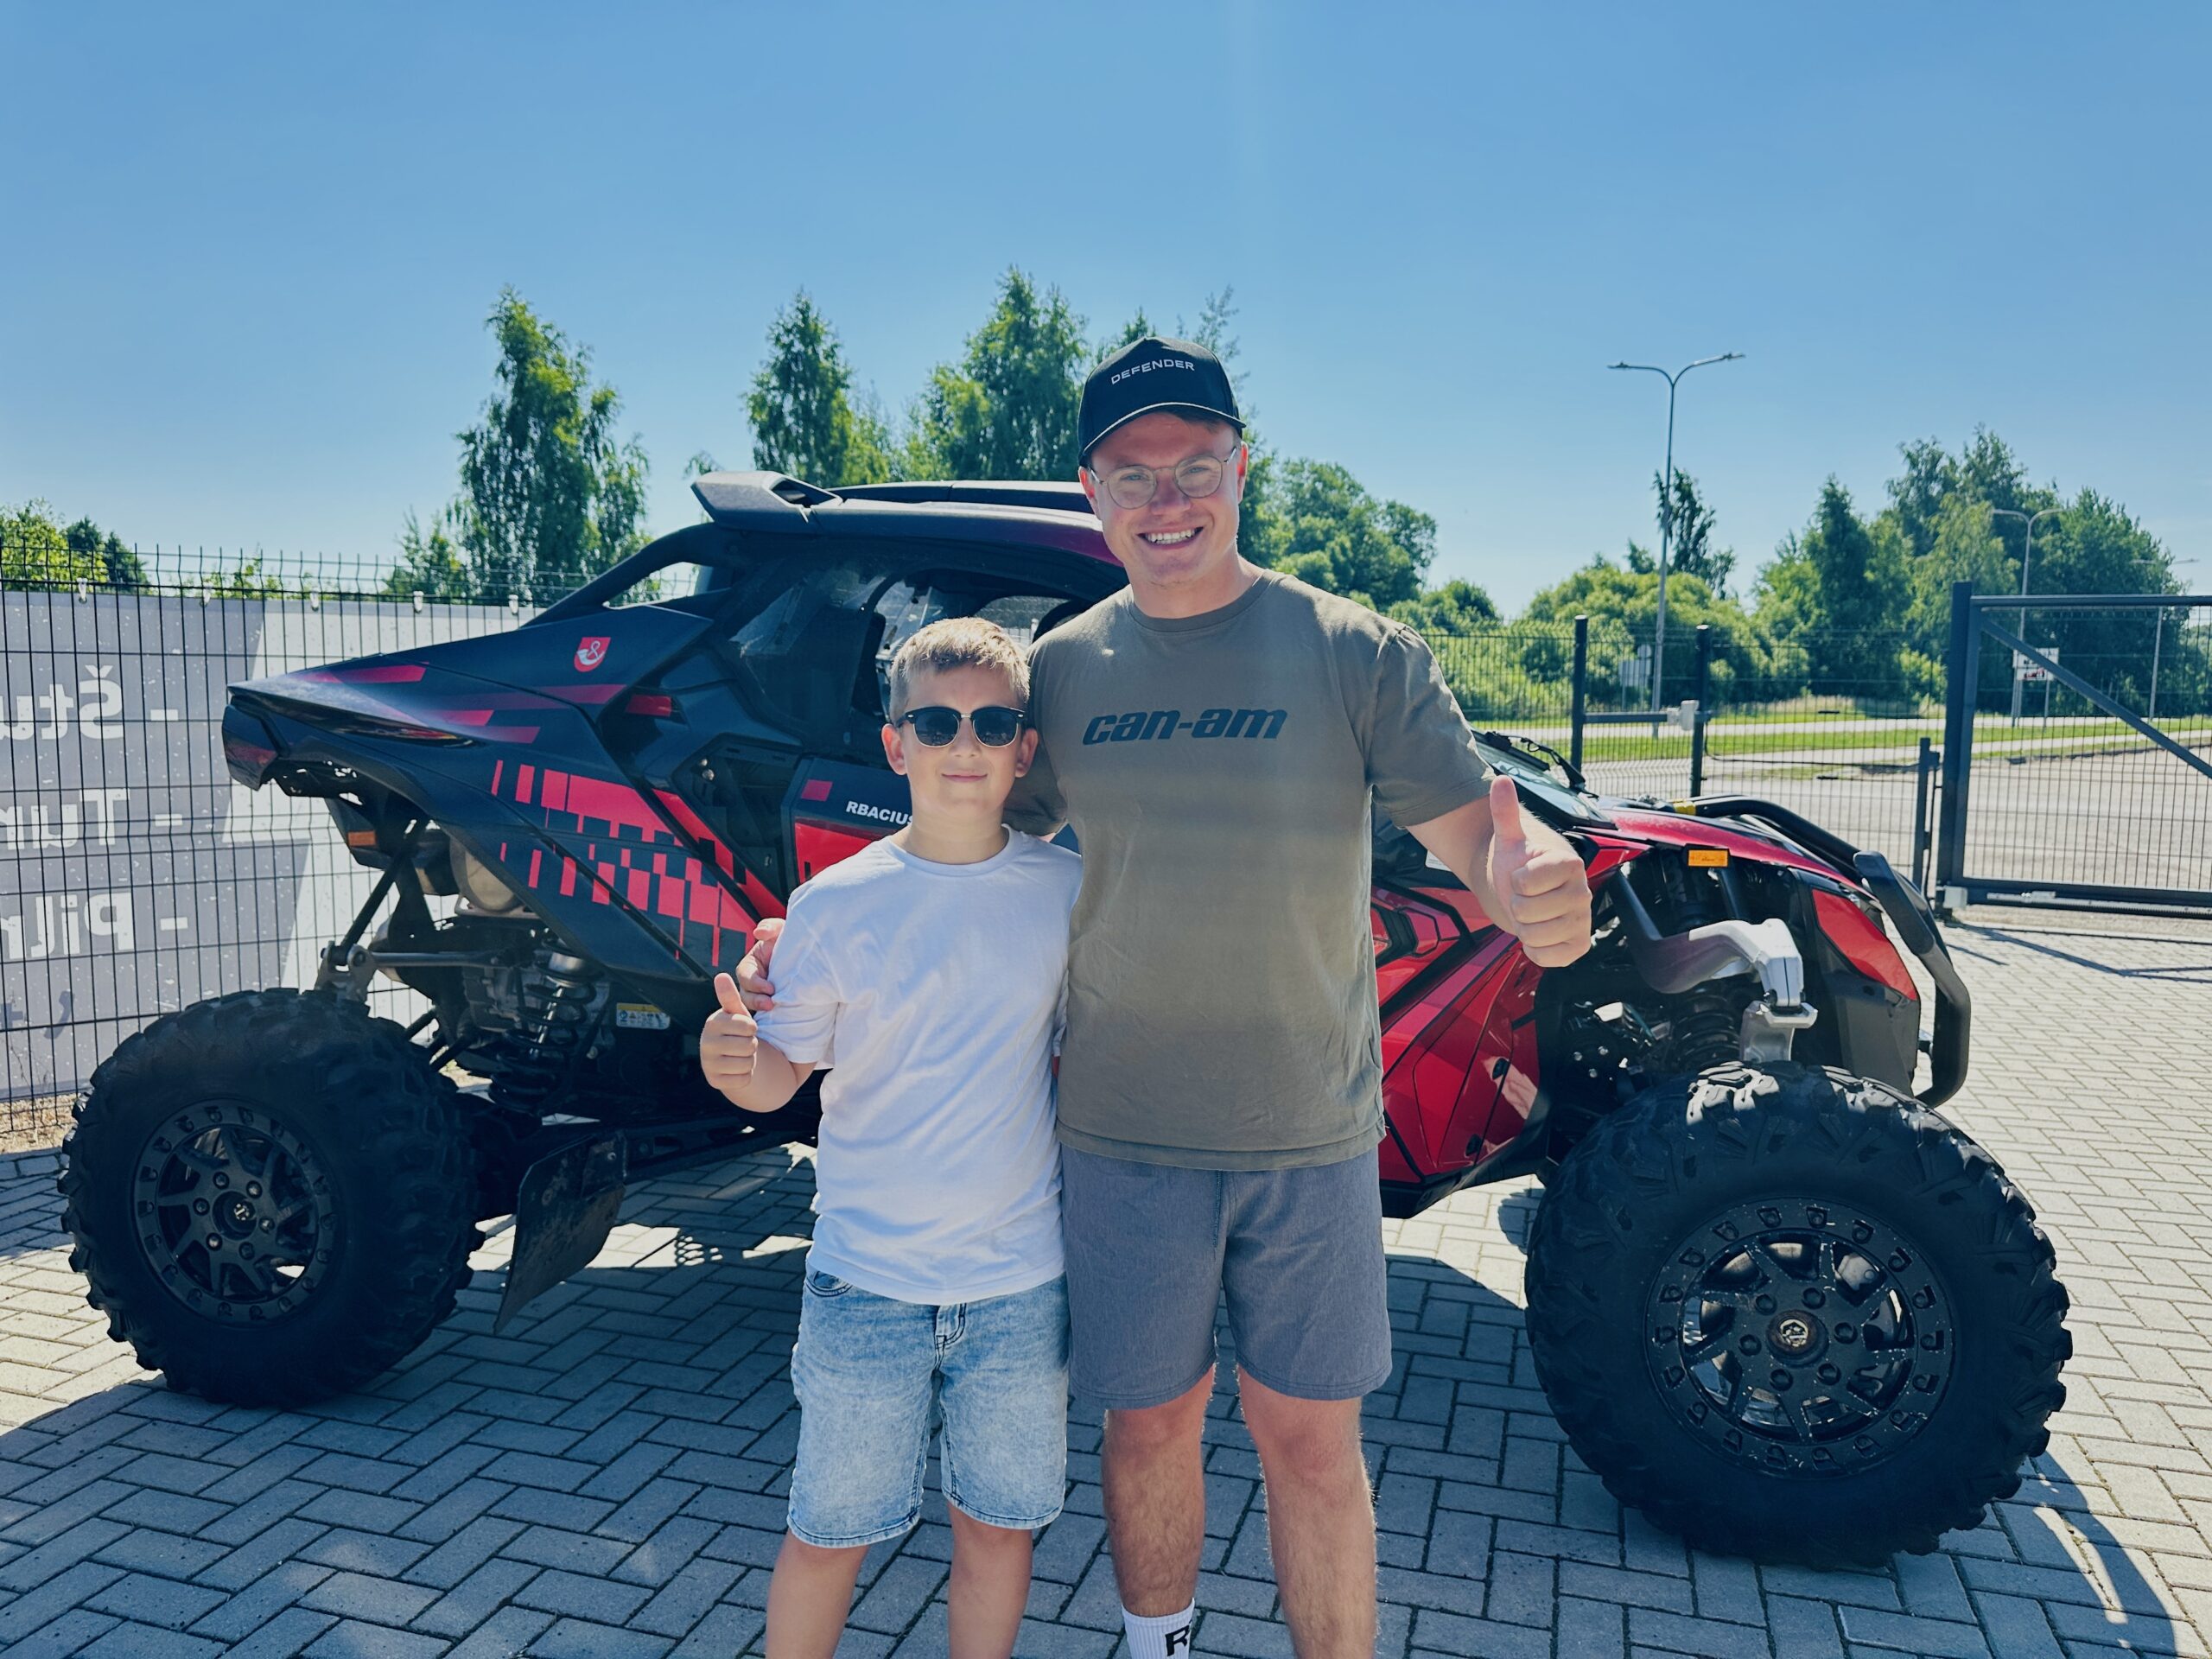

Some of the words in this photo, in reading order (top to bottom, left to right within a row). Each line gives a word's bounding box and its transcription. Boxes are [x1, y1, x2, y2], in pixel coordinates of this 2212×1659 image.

[1111, 359, 1195, 385] DEFENDER
[1082, 709, 1287, 745] can-am
[1165, 1620, 1192, 1656] R
